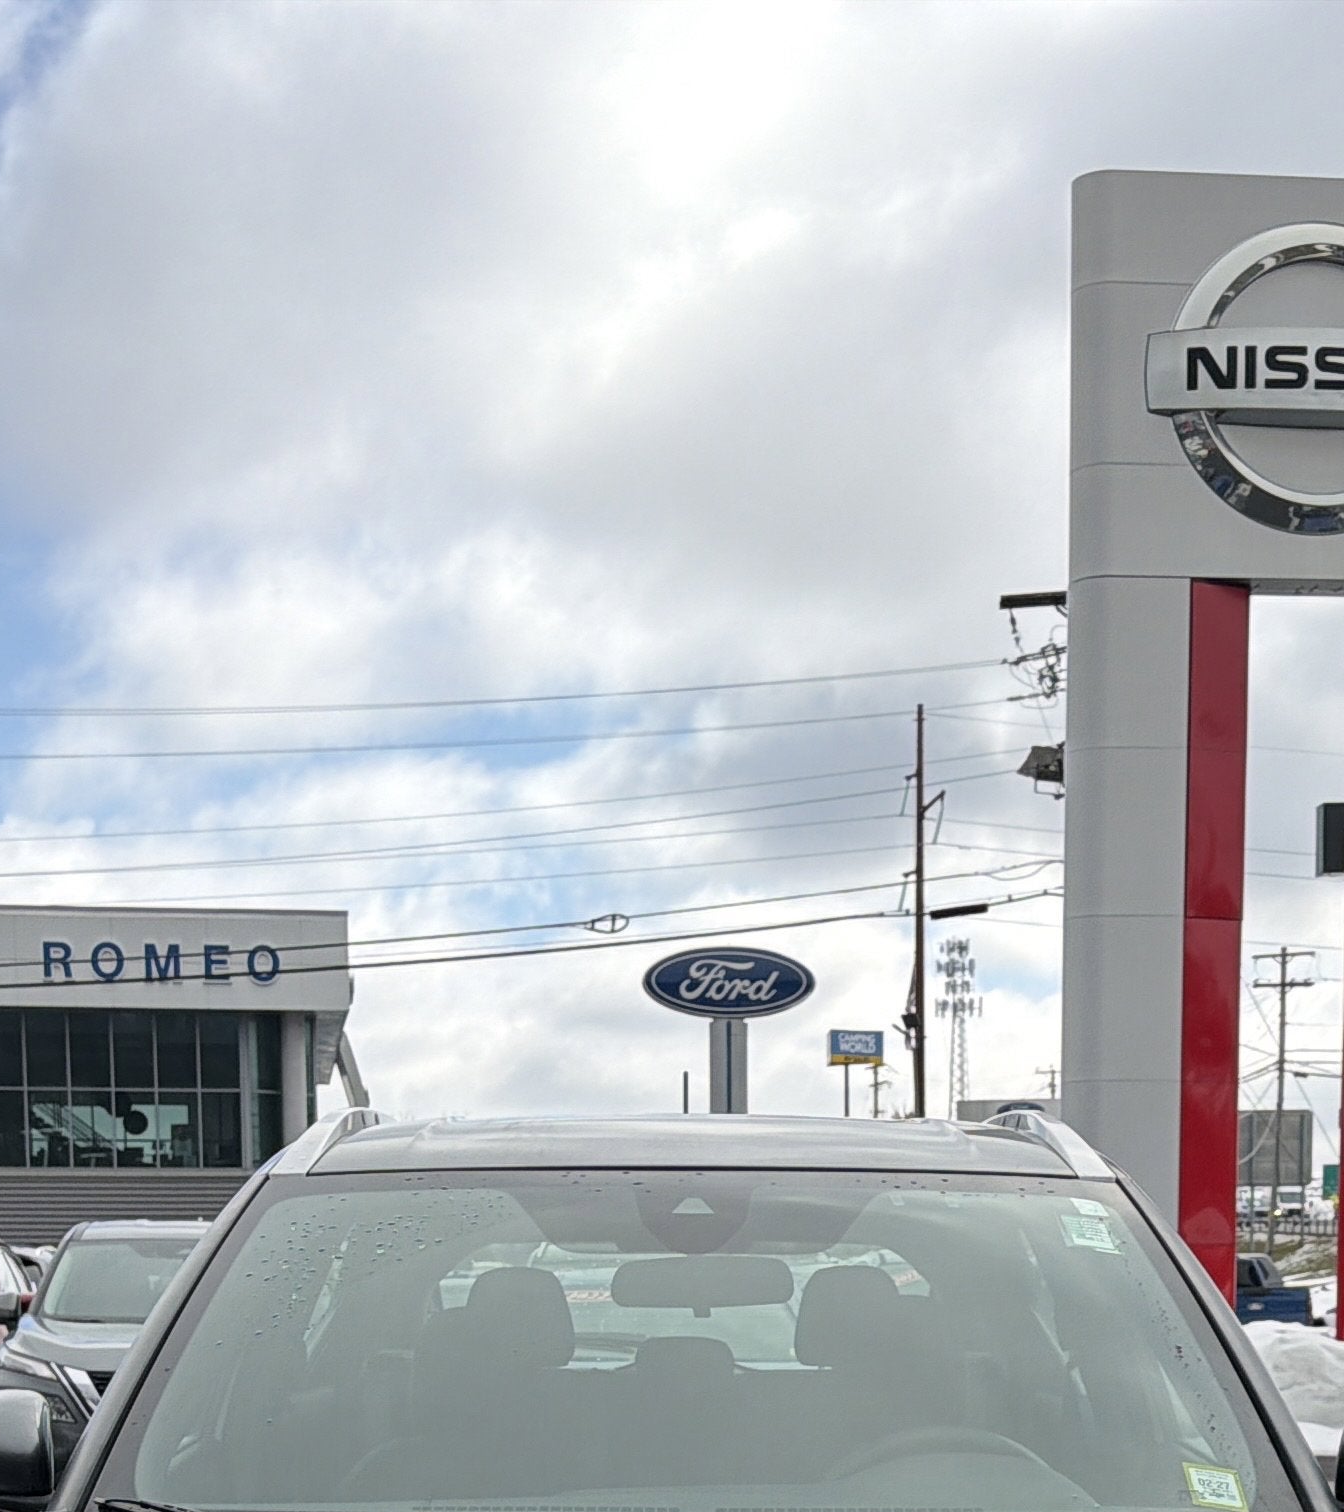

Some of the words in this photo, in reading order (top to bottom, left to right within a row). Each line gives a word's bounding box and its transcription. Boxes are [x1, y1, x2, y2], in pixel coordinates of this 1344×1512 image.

[42, 941, 280, 984] ROMEO
[679, 959, 780, 1001] Ford
[838, 1033, 875, 1043] CAMPING
[839, 1041, 876, 1054] WORLD
